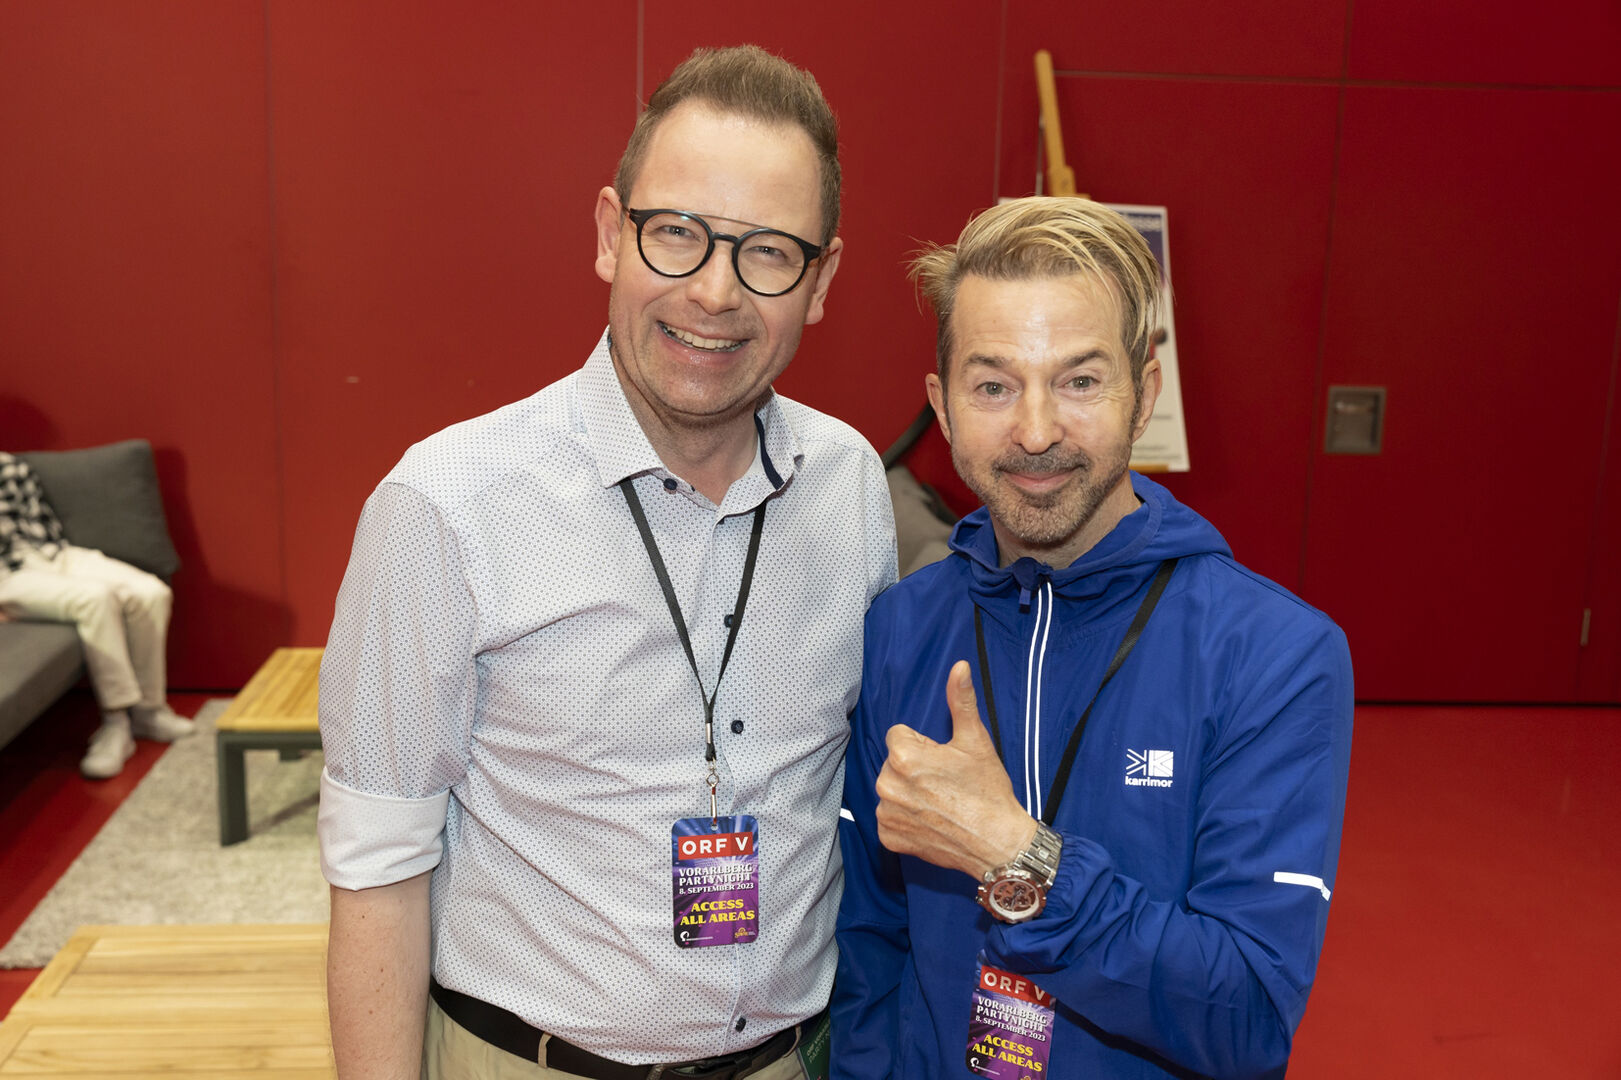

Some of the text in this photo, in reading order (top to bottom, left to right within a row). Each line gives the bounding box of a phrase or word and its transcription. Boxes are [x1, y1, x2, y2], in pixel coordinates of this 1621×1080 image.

[1125, 776, 1173, 788] karrimor
[682, 836, 748, 855] ORF V
[679, 863, 753, 877] VORARLBERG
[679, 873, 752, 886] PARTYNIGHT
[687, 884, 735, 894] SEPTEMBER
[737, 882, 754, 890] 2023
[691, 899, 744, 912] ACCESS
[680, 910, 755, 925] ALL AREAS
[984, 972, 1046, 1001] ORF V
[977, 1005, 1045, 1033] PARTYNIGHT
[978, 996, 1047, 1024] VORARLBERG
[983, 1017, 1027, 1036] SEPTEMBER
[1029, 1031, 1046, 1042] 2023
[983, 1034, 1034, 1057] ACCESS
[972, 1043, 996, 1058] ALL
[998, 1051, 1043, 1072] AREAS
